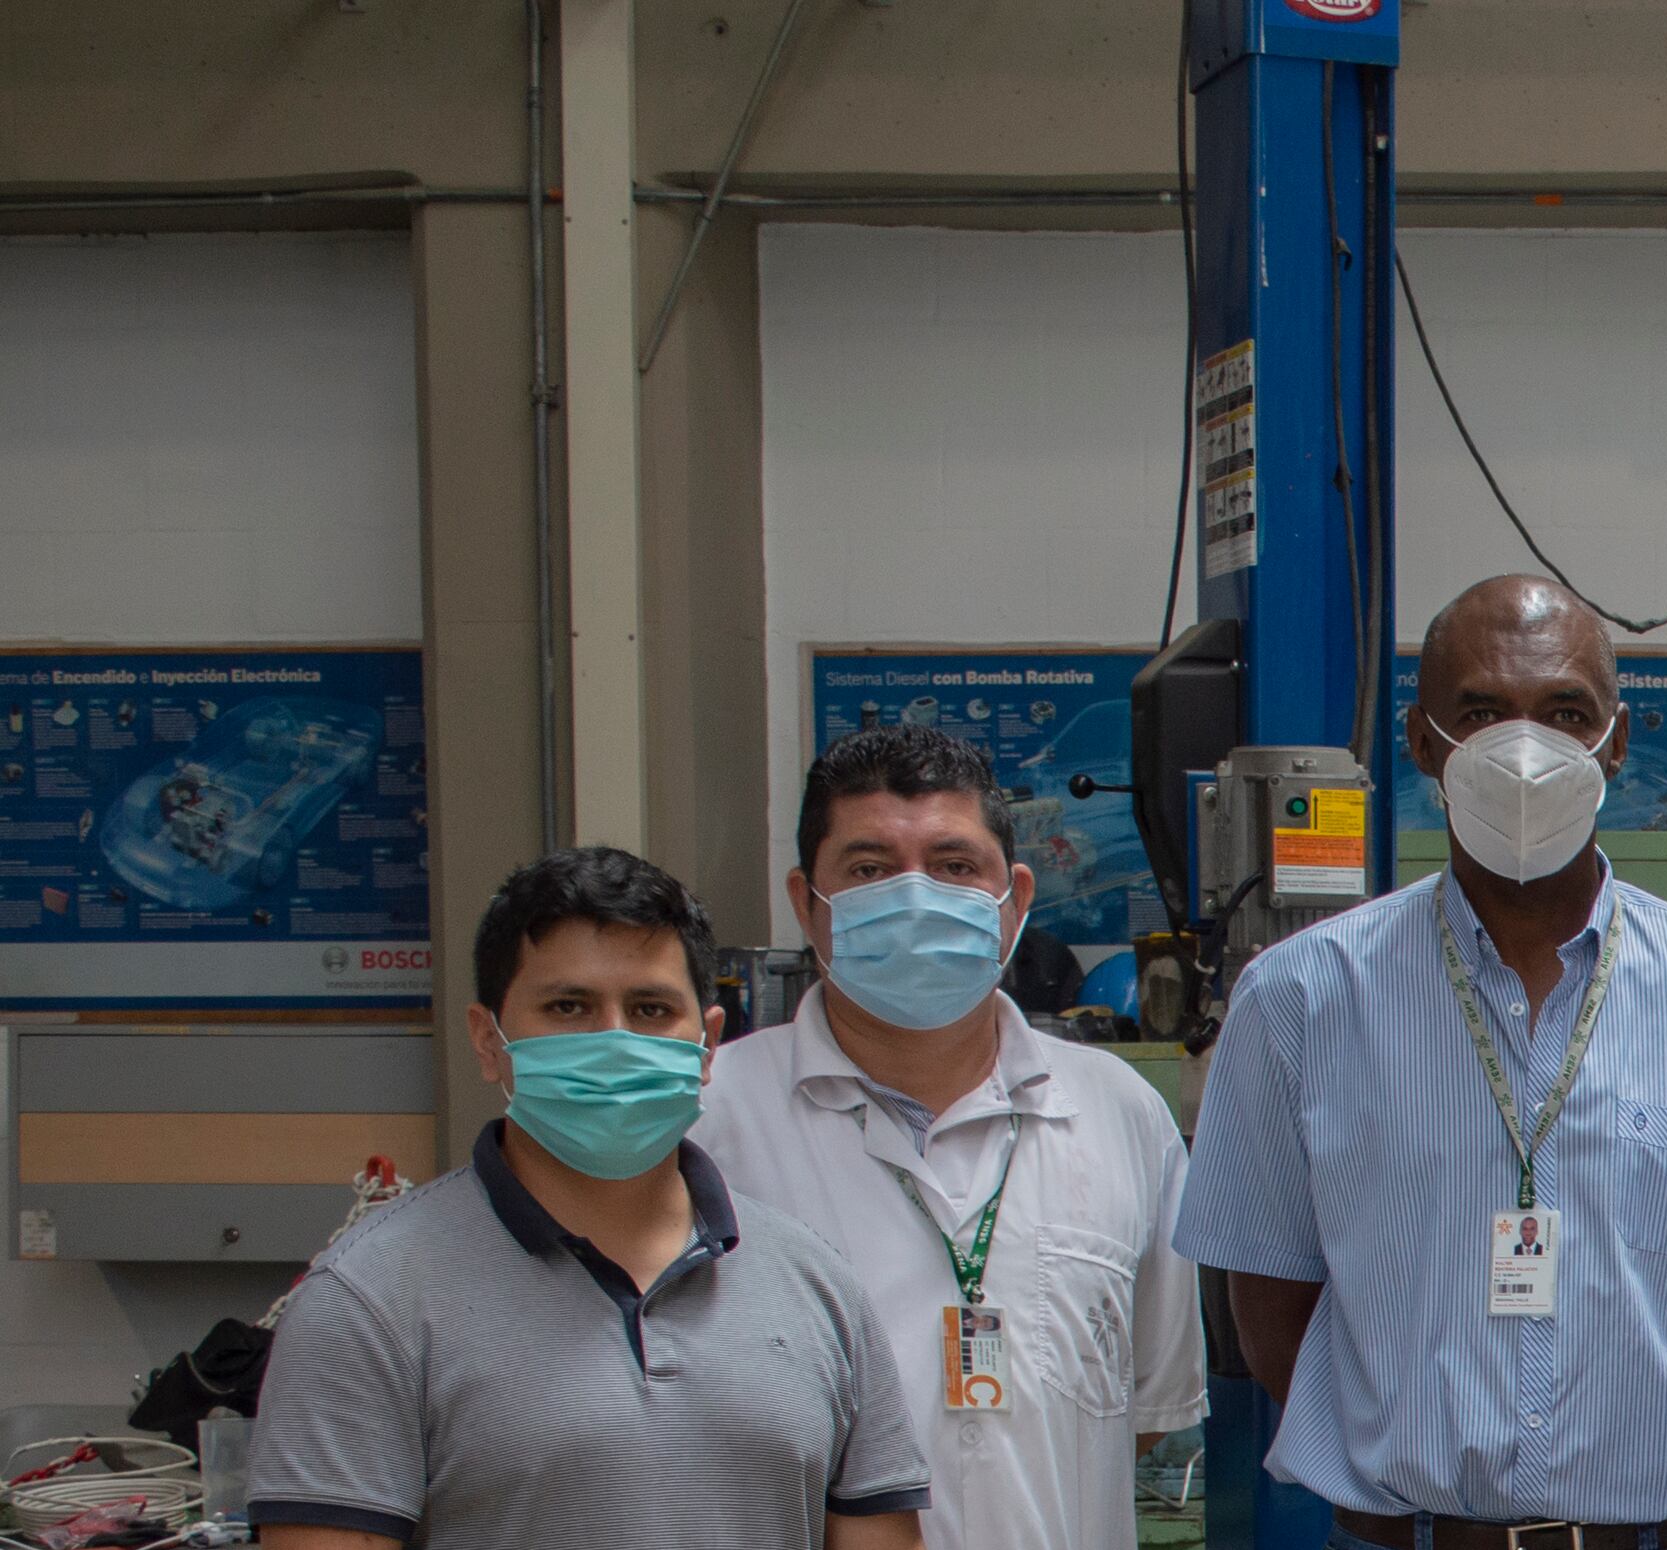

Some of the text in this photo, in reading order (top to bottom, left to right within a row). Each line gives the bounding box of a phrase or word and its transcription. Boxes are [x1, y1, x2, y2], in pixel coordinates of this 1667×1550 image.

[32, 671, 49, 686] de
[53, 669, 137, 685] Encendido
[152, 668, 228, 687] Inyección
[231, 667, 321, 684] Electrónica
[825, 670, 1095, 687] Sistema Diesel con Bomba Rotativa
[979, 1218, 994, 1244] SENA
